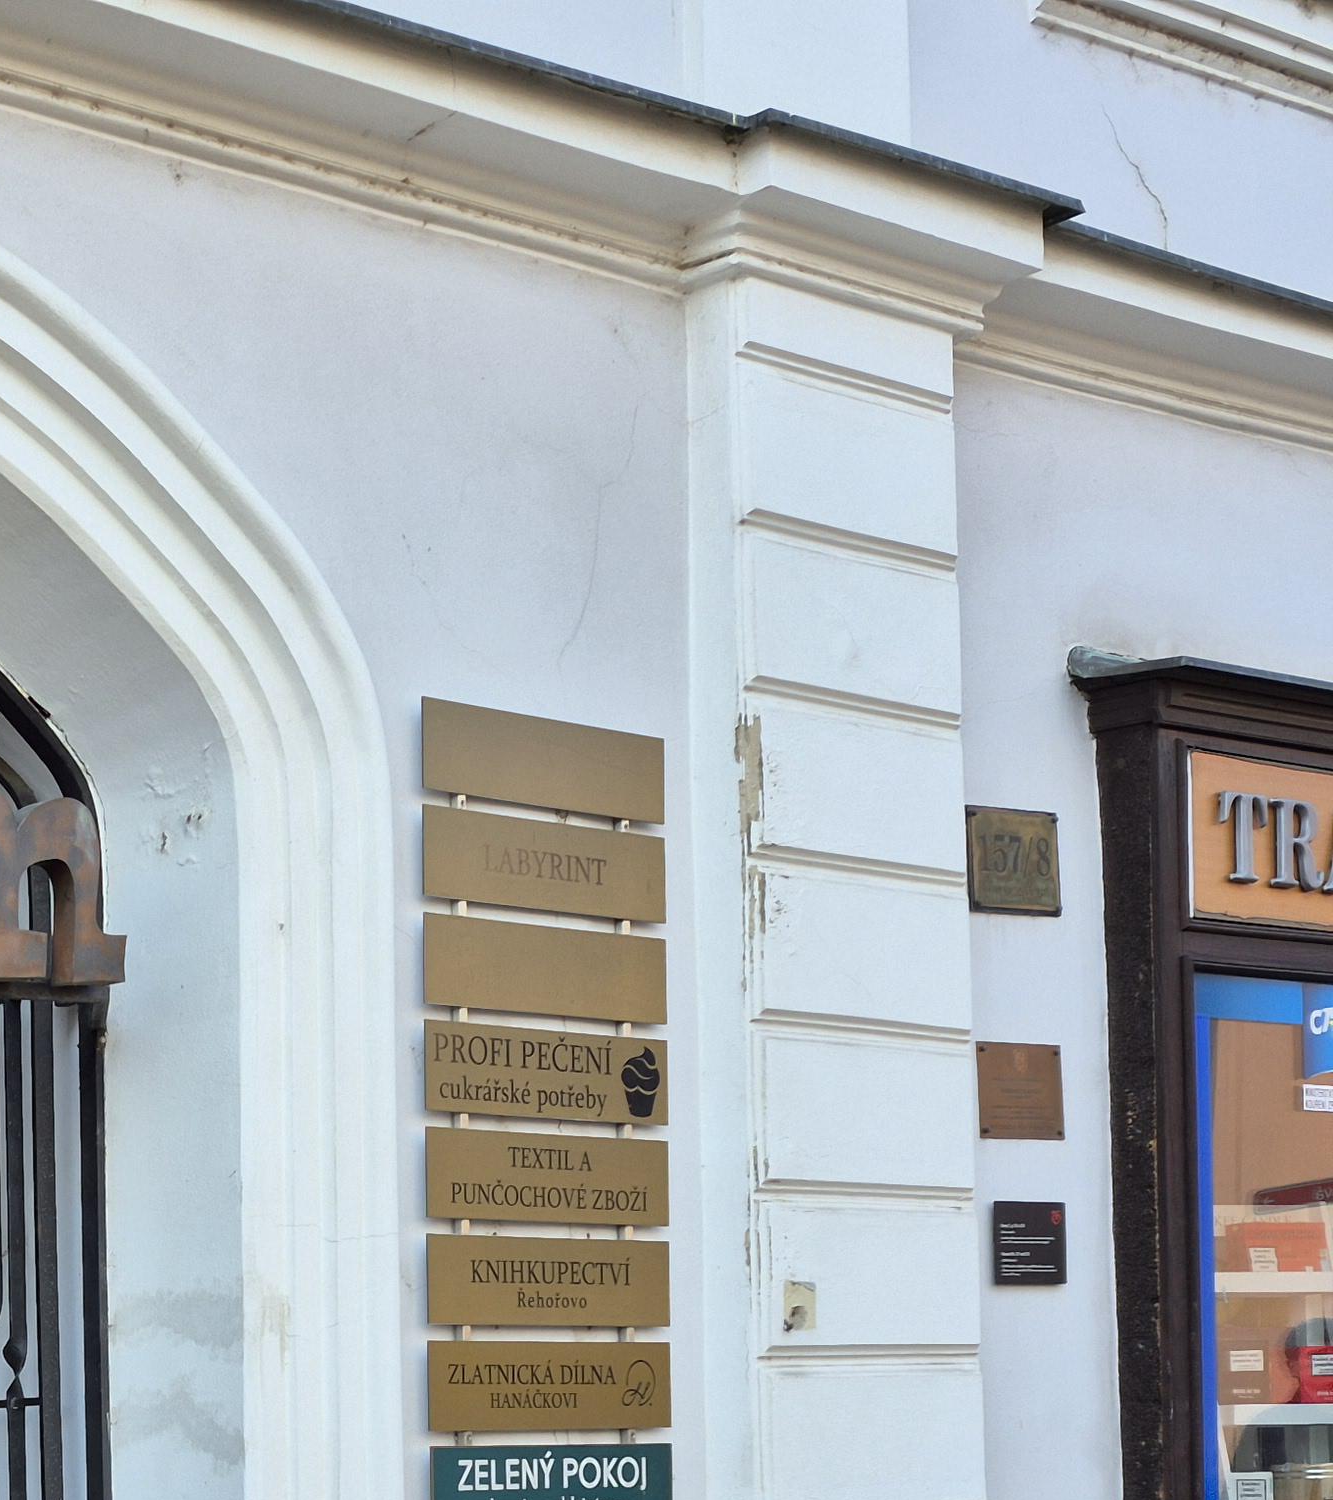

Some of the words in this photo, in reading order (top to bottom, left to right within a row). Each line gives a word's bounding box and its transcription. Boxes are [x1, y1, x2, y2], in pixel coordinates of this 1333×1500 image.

[979, 833, 1051, 878] 157/8
[1217, 790, 1333, 893] TR
[483, 844, 608, 886] LABYRINT
[433, 1032, 513, 1067] PROFI
[520, 1038, 613, 1075] PEČENÍ
[439, 1077, 531, 1105] cukrářské
[537, 1082, 607, 1117] potřeby
[508, 1146, 574, 1171] TEXTIL
[579, 1152, 592, 1172] A
[451, 1181, 587, 1209] PUNČOCHOVÉ
[592, 1188, 648, 1212] ZBOŽÍ
[471, 1257, 631, 1286] KNIHKUPECTVÍ
[516, 1289, 588, 1310] Řehořovo
[448, 1360, 554, 1386] ZLATNICKÁ
[560, 1360, 617, 1386] DÍLNA
[490, 1389, 578, 1409] HANÁČKOVI
[458, 1450, 554, 1492] ZELENÝ
[563, 1456, 648, 1491] POKOJ
